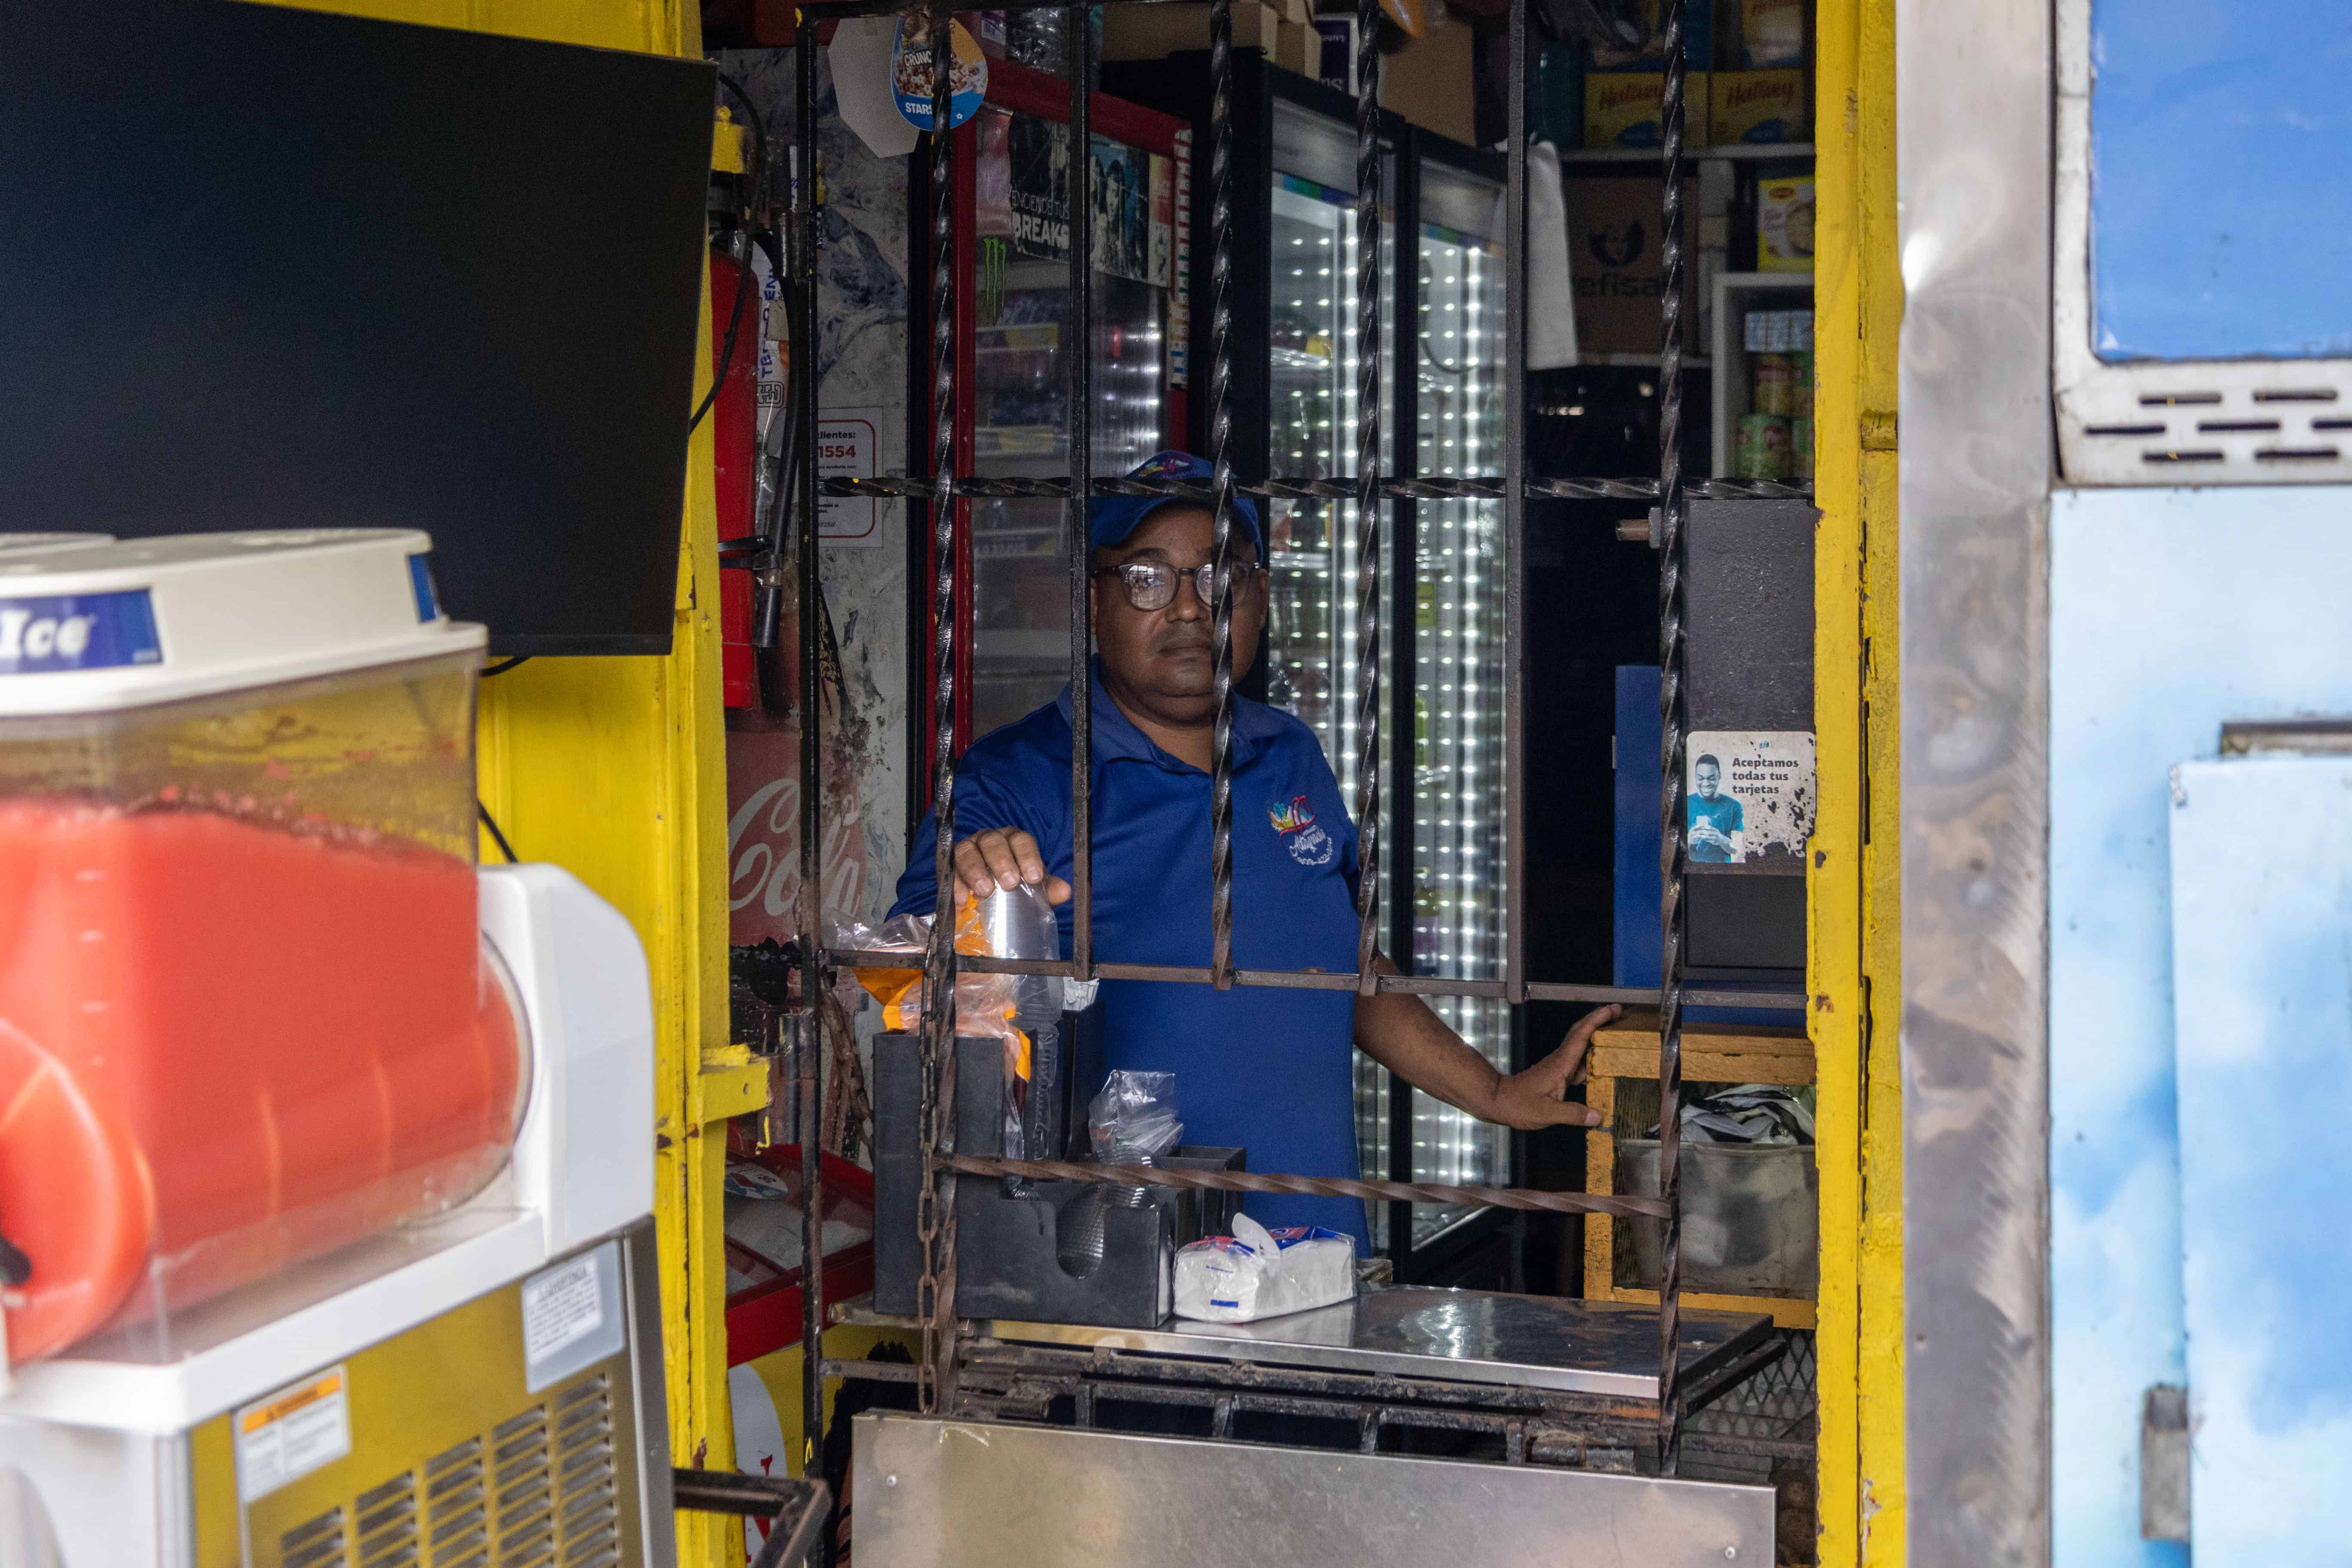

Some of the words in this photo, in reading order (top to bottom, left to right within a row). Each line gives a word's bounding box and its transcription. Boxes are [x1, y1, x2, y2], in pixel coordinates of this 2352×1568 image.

[904, 50, 932, 67] CRUNC
[1732, 757, 1799, 769] Aceptamos
[1732, 771, 1766, 780] todas
[1769, 772, 1789, 780] tus
[1732, 784, 1779, 796] tarjetas
